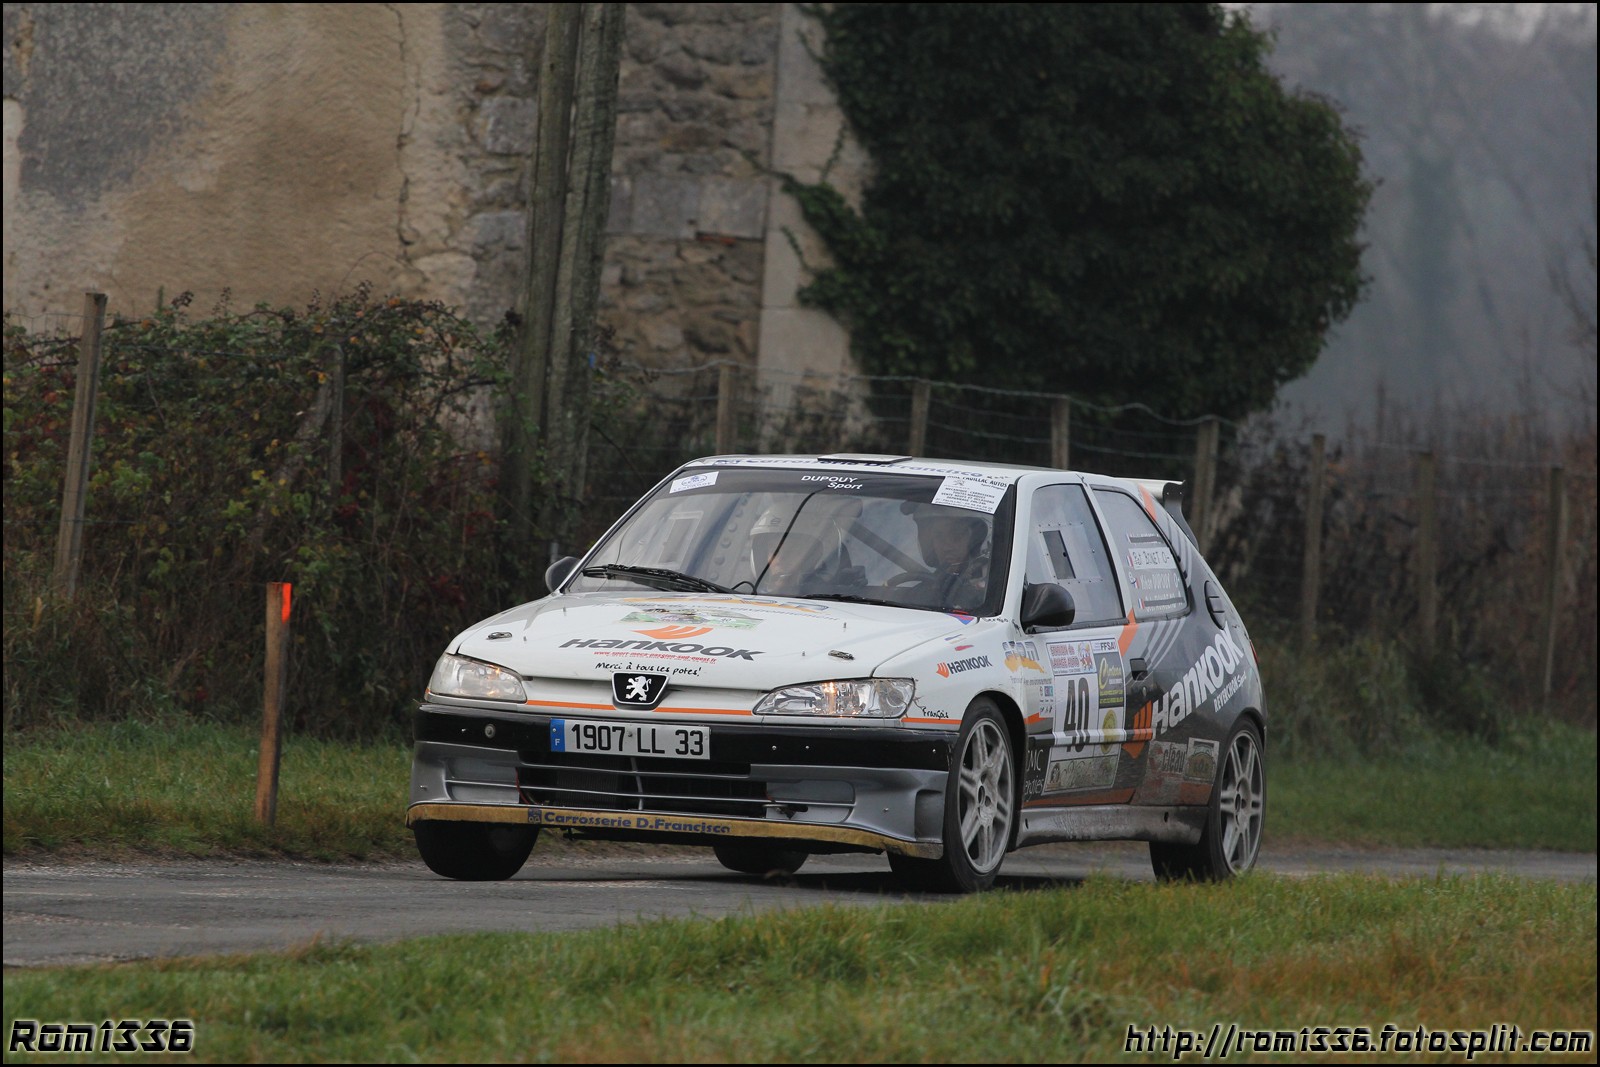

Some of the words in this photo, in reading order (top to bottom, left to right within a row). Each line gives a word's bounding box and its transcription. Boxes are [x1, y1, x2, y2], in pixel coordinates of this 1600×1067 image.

[801, 475, 858, 483] DUPOUY
[827, 481, 863, 489] Sport
[1101, 641, 1116, 651] FFSA
[626, 661, 632, 670] à
[636, 664, 653, 672] tous
[673, 667, 702, 677] potes!
[1064, 677, 1090, 753] 40
[555, 738, 560, 746] F
[571, 723, 626, 751] 1907
[637, 727, 666, 754] LL
[675, 729, 704, 756] 33
[544, 812, 632, 828] Carrosserie
[636, 817, 731, 834] D.Francisco
